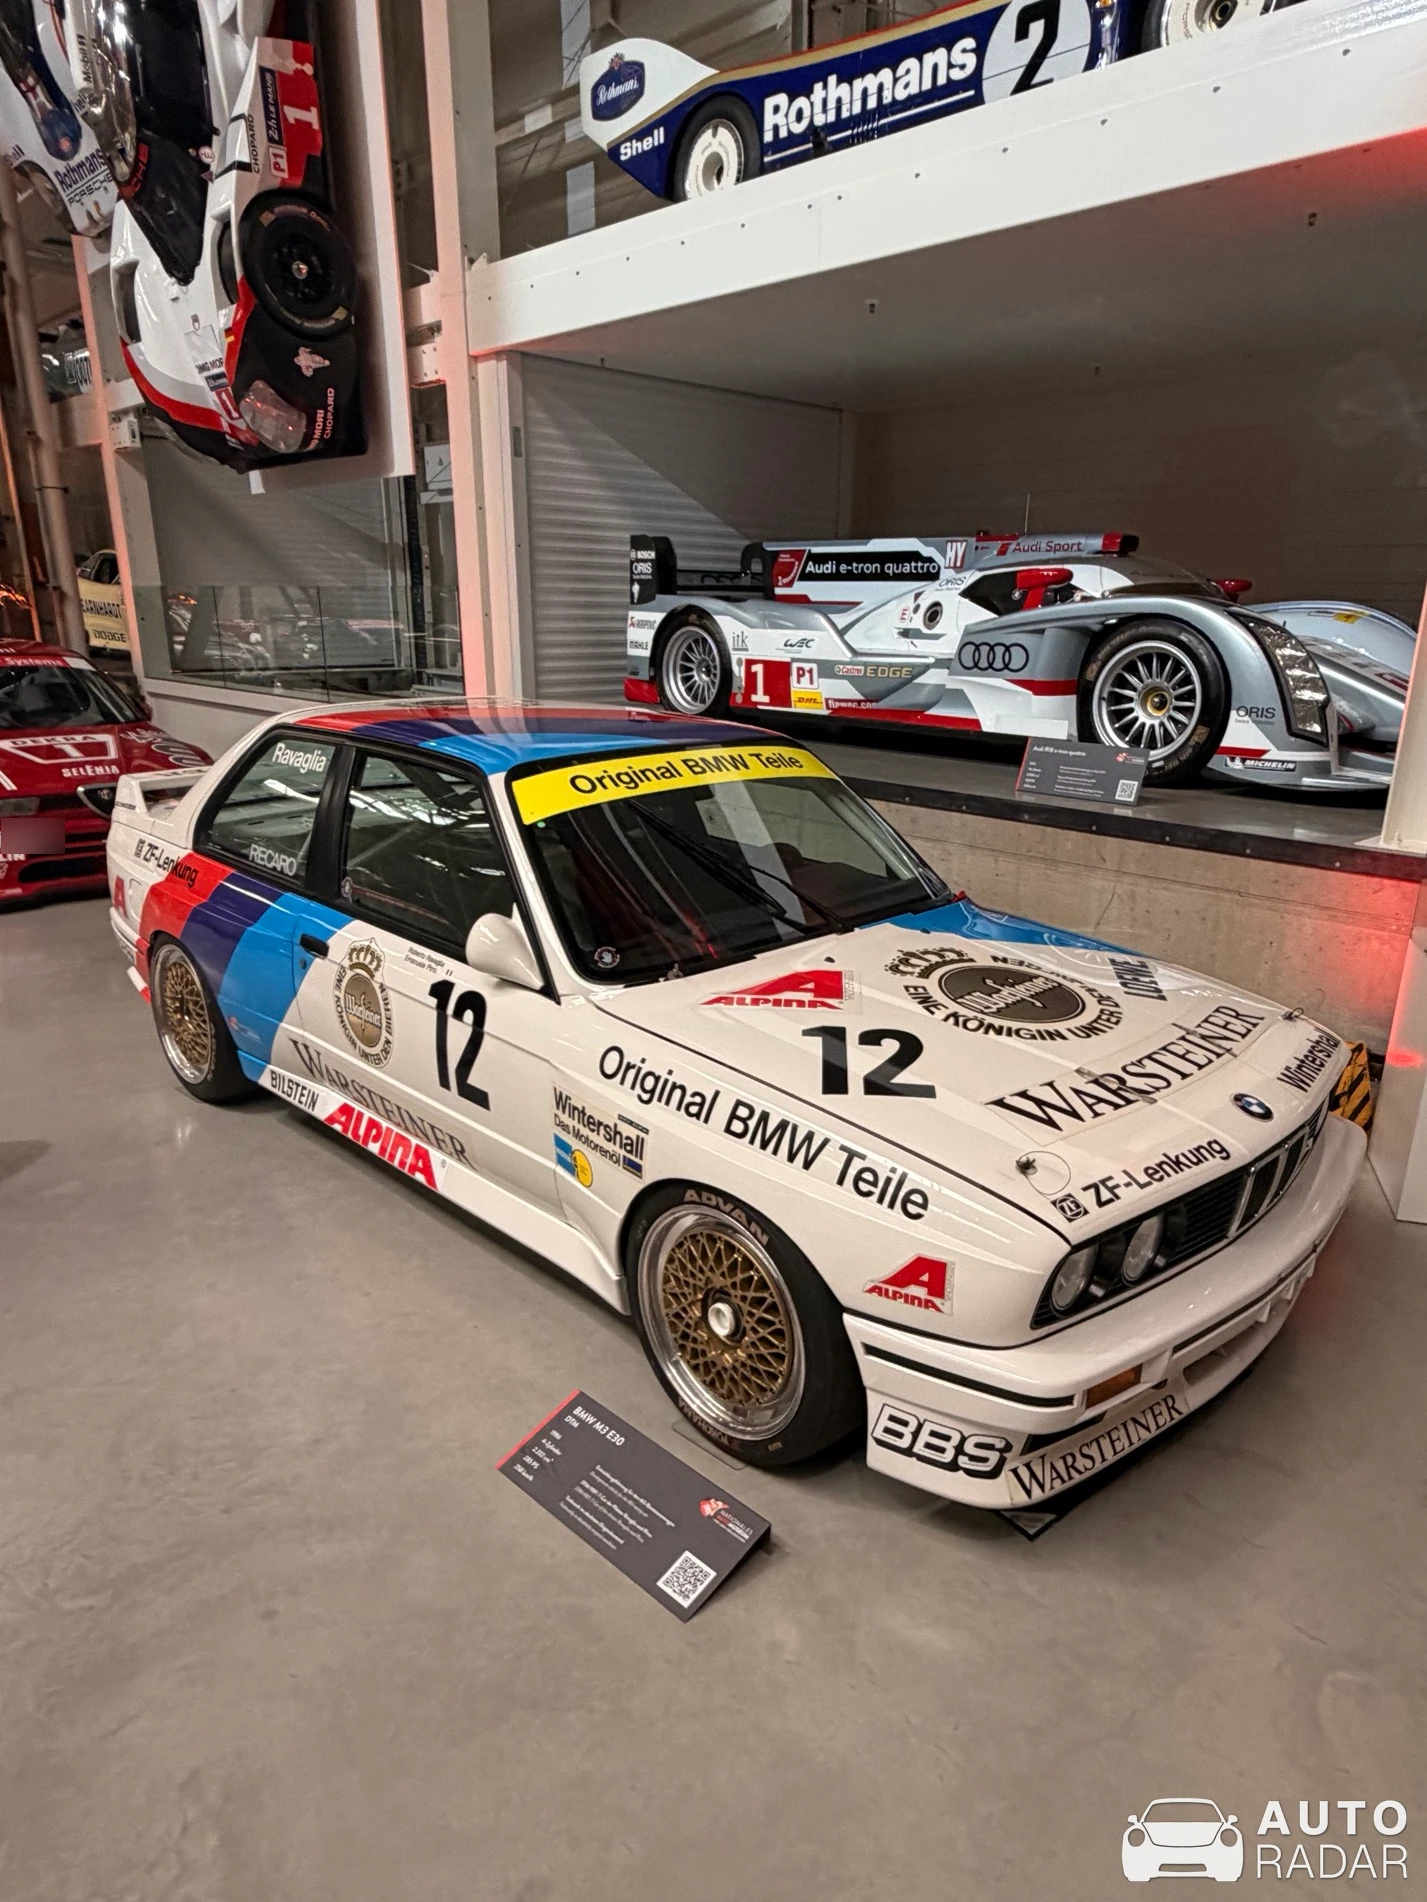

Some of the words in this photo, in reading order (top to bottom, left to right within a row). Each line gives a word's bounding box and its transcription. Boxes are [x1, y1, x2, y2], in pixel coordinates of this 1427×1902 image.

[1009, 0, 1060, 97] 2
[596, 73, 639, 106] Rothmans
[763, 36, 977, 144] Rothmans
[282, 104, 320, 130] 1
[247, 113, 261, 175] CHOPARD
[272, 152, 287, 173] P1
[619, 126, 665, 161] Shell
[54, 149, 107, 193] Rothmans
[323, 387, 335, 439] CHOPARD
[632, 562, 653, 575] ORIS
[805, 561, 837, 574] Audi
[839, 563, 882, 574] e-tron
[884, 562, 939, 576] quattro
[945, 542, 967, 569] HY
[1013, 542, 1041, 553] Audi
[1045, 541, 1082, 554] Sport
[938, 576, 967, 588] ORIS
[93, 629, 127, 643] DODGE
[783, 638, 815, 649] WEC
[750, 664, 770, 704] 1
[796, 666, 815, 685] P1
[841, 665, 863, 676] Castrol
[866, 666, 913, 678] EDGE
[1236, 705, 1276, 719] ORIS
[10, 735, 97, 746] DEKRA
[271, 743, 327, 774] Ravaglia
[61, 764, 120, 778] SELENIA
[569, 760, 682, 795] Original
[683, 753, 750, 776] BMW
[750, 752, 804, 770] Teile
[1244, 760, 1296, 770] MICHELIN
[142, 843, 199, 889] ZF-Lenkung
[248, 844, 298, 876] RECARO
[1108, 958, 1168, 1001] LOEWE
[334, 965, 347, 993] EINE
[381, 1036, 393, 1061] DEN
[700, 995, 844, 1010] ALPINA
[903, 984, 944, 1016] EINE
[942, 1010, 1070, 1042] KÖNIGIN
[1066, 1006, 1123, 1040] UNTER
[428, 979, 491, 1112] 12
[801, 1025, 937, 1099] 12
[1276, 1026, 1341, 1093] Wintershall
[984, 1005, 1266, 1133] WARSTEINER
[269, 1069, 320, 1113] BILSTEIN
[289, 1037, 478, 1172] WARSTEINER
[553, 1086, 645, 1161] Wintershall
[554, 1112, 571, 1135] Das
[572, 1125, 621, 1167] Motorenöl
[598, 1045, 721, 1124] Original
[723, 1099, 831, 1171] BMW
[837, 1143, 930, 1220] Teile
[322, 1102, 439, 1191] ALPINA
[1060, 1199, 1085, 1217] ZF
[1082, 1137, 1231, 1208] ZF-Lenkung
[683, 1189, 770, 1246] ADVAN
[863, 1285, 946, 1314] ALPINA
[564, 1415, 580, 1429] DTM
[572, 1405, 597, 1425] BMW
[592, 1421, 610, 1435] M3
[605, 1430, 626, 1446] E30
[872, 1403, 1013, 1480] BBS
[1008, 1393, 1186, 1501] WARSTEINER
